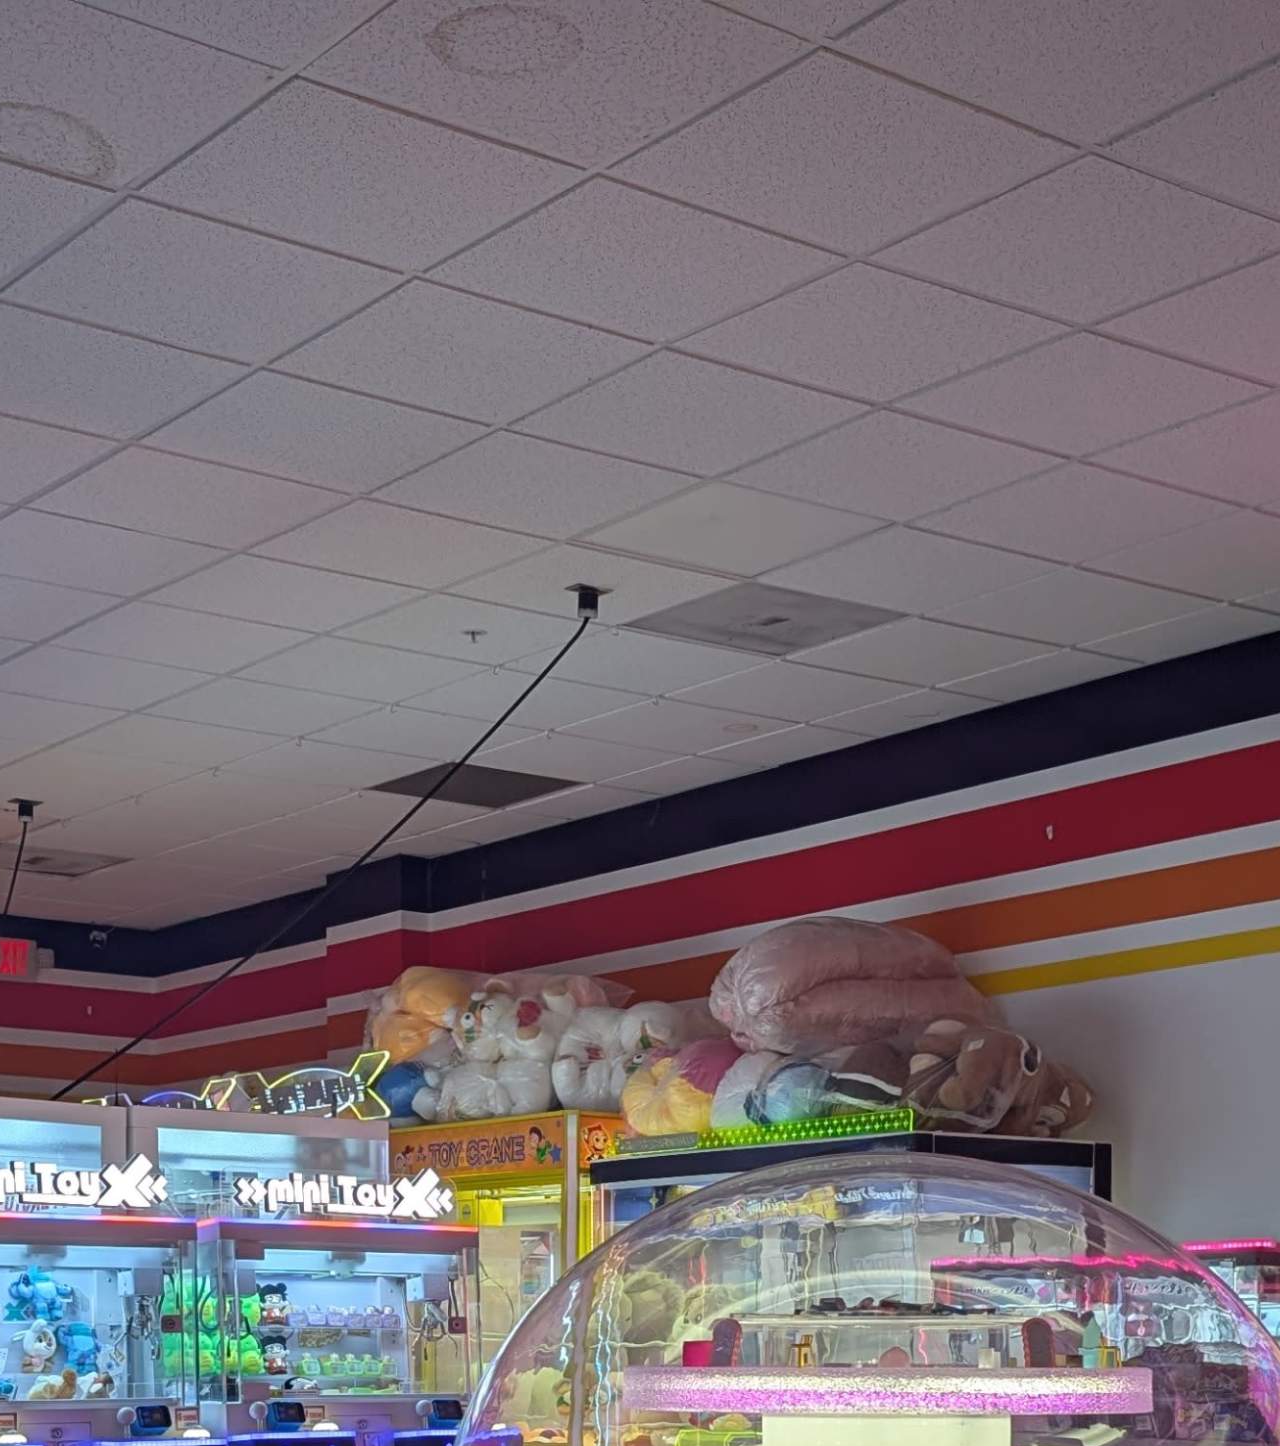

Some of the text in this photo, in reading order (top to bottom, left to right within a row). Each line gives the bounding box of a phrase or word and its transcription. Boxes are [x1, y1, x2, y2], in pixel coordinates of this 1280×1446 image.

[428, 1135, 526, 1169] TOY CRANE
[266, 1173, 329, 1213] mini
